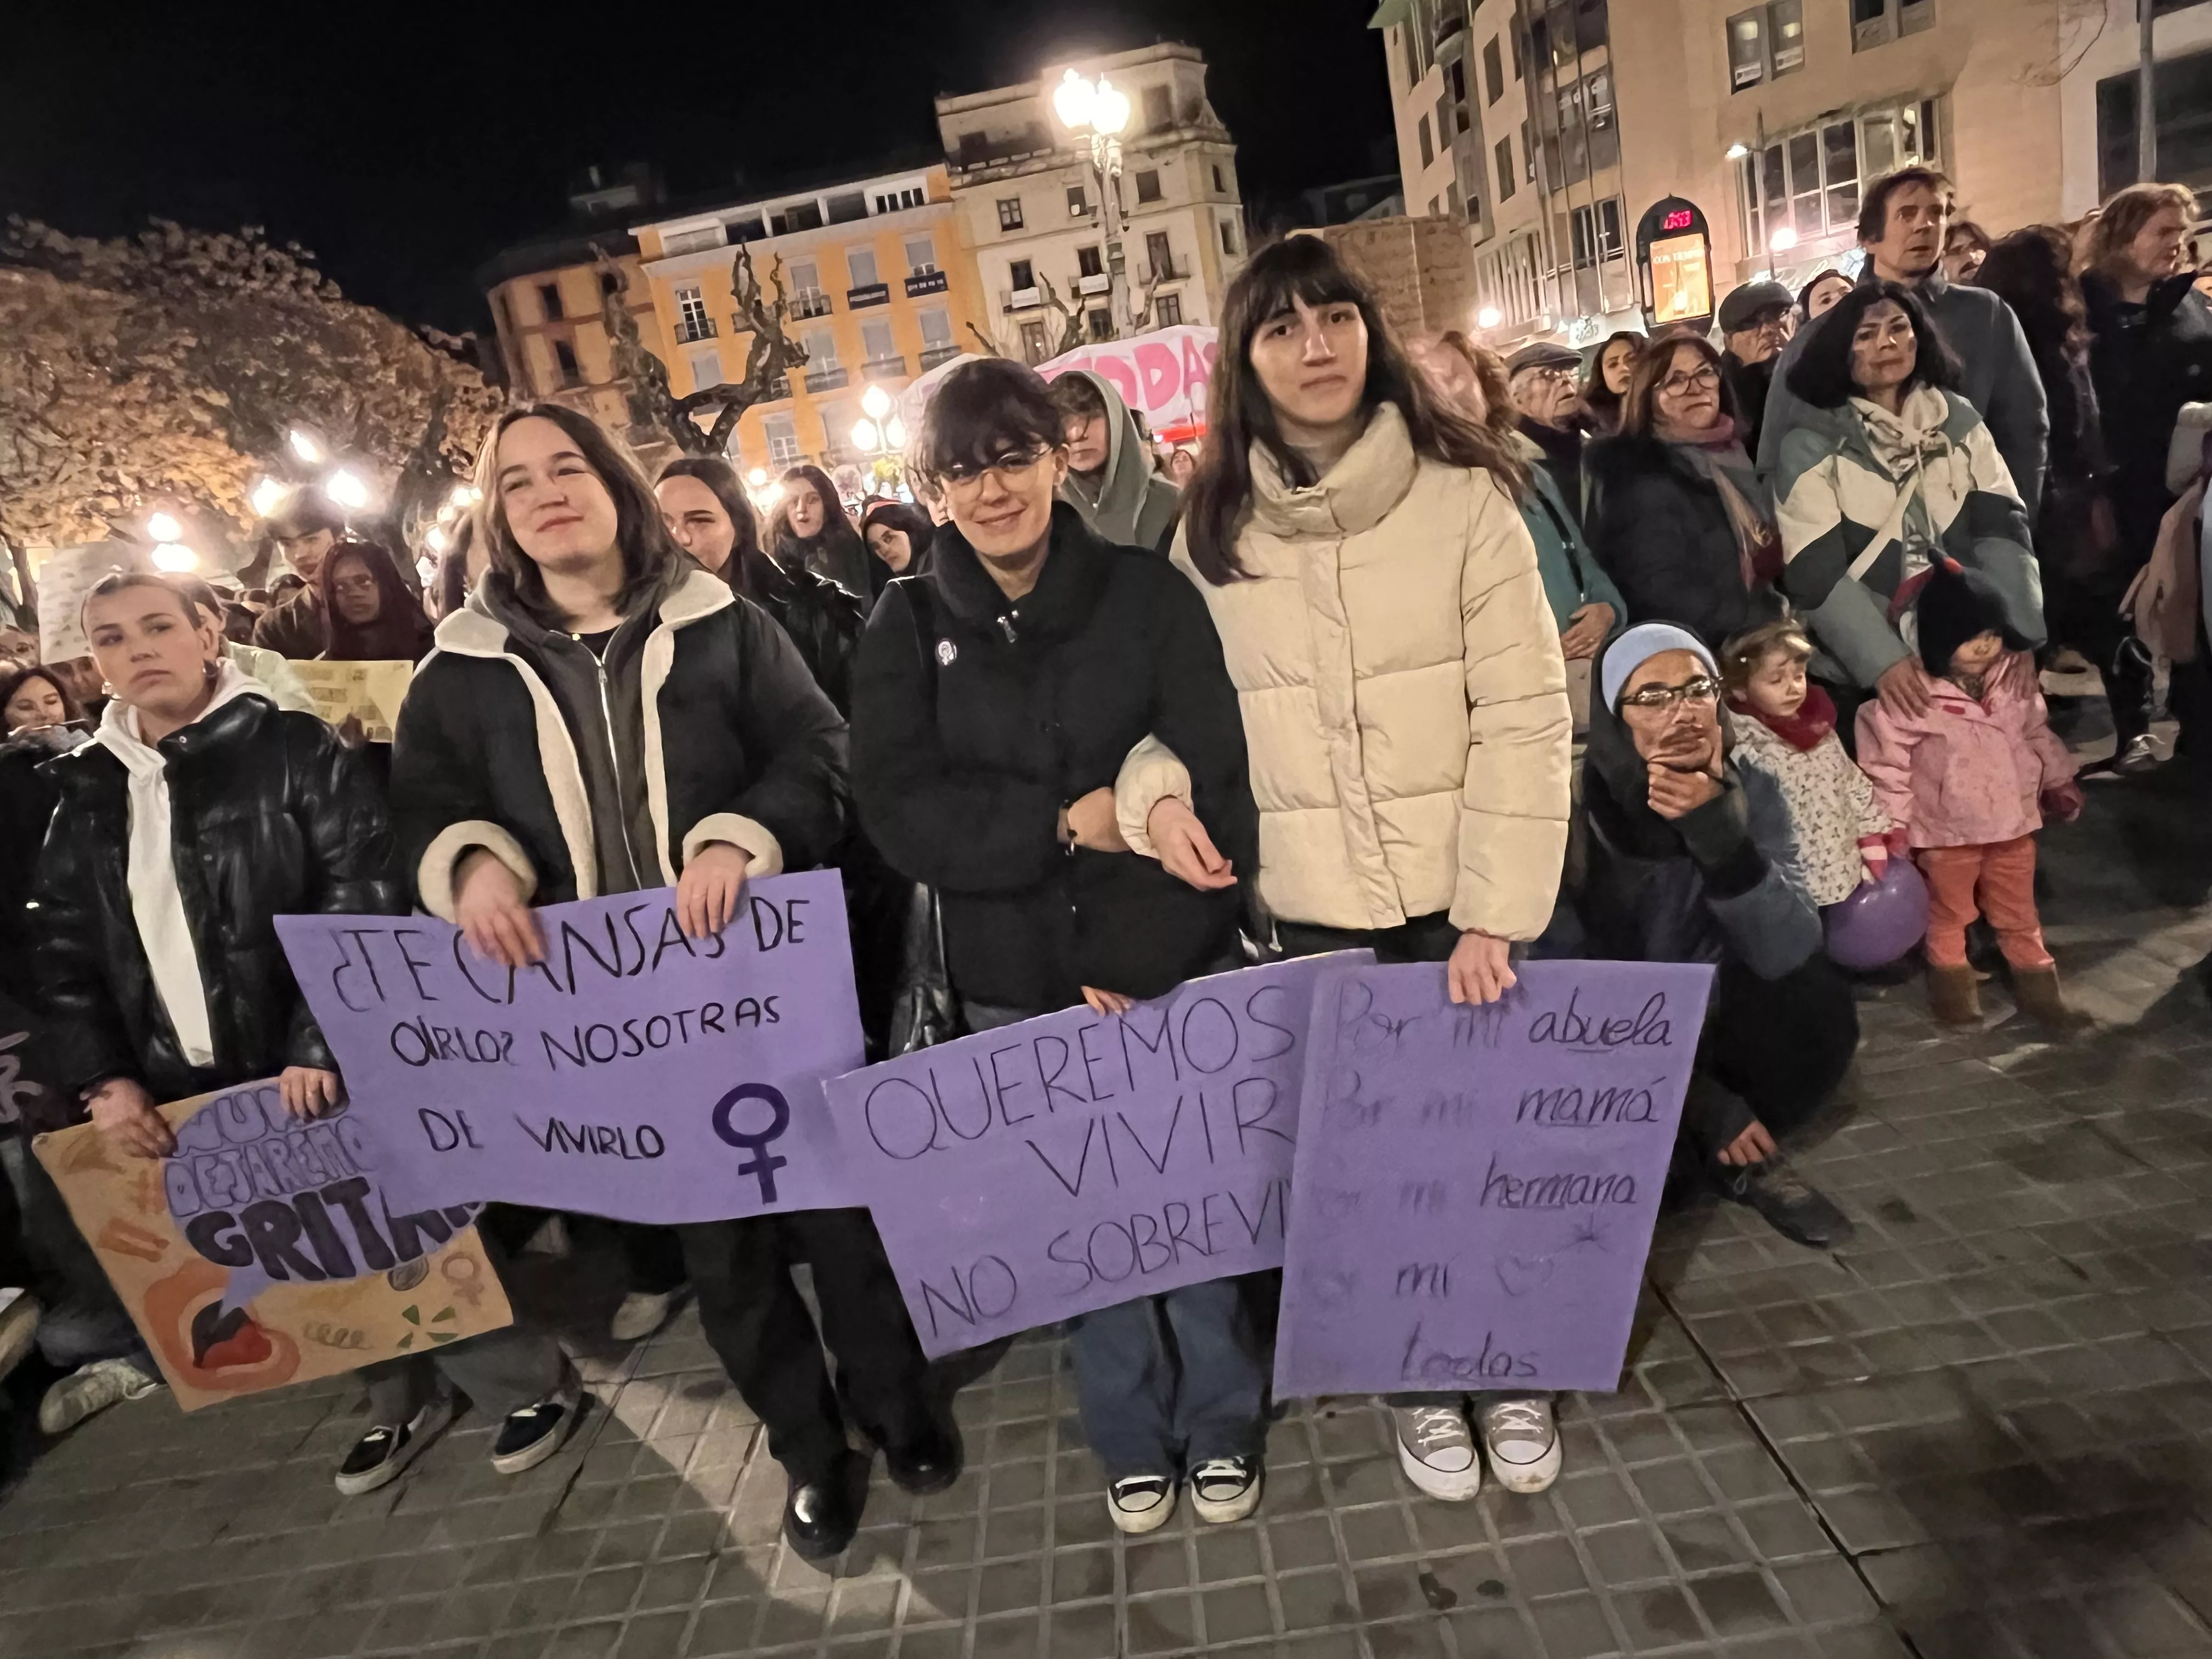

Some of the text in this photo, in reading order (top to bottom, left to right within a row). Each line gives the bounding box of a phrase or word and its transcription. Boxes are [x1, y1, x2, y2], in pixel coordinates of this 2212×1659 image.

[750, 896, 810, 952] DE
[540, 995, 781, 1071] NOSOTRAS
[1528, 986, 1673, 1047] abuela
[865, 985, 1295, 1160] QUEREMOS
[1515, 1075, 1667, 1124] mamá
[418, 1108, 665, 1160] DE VIVIRLO
[1025, 1076, 1296, 1198] VIVIR
[1480, 1151, 1638, 1208] hermana
[919, 1255, 1017, 1338] NO
[1047, 1179, 1291, 1297] SOBREVI
